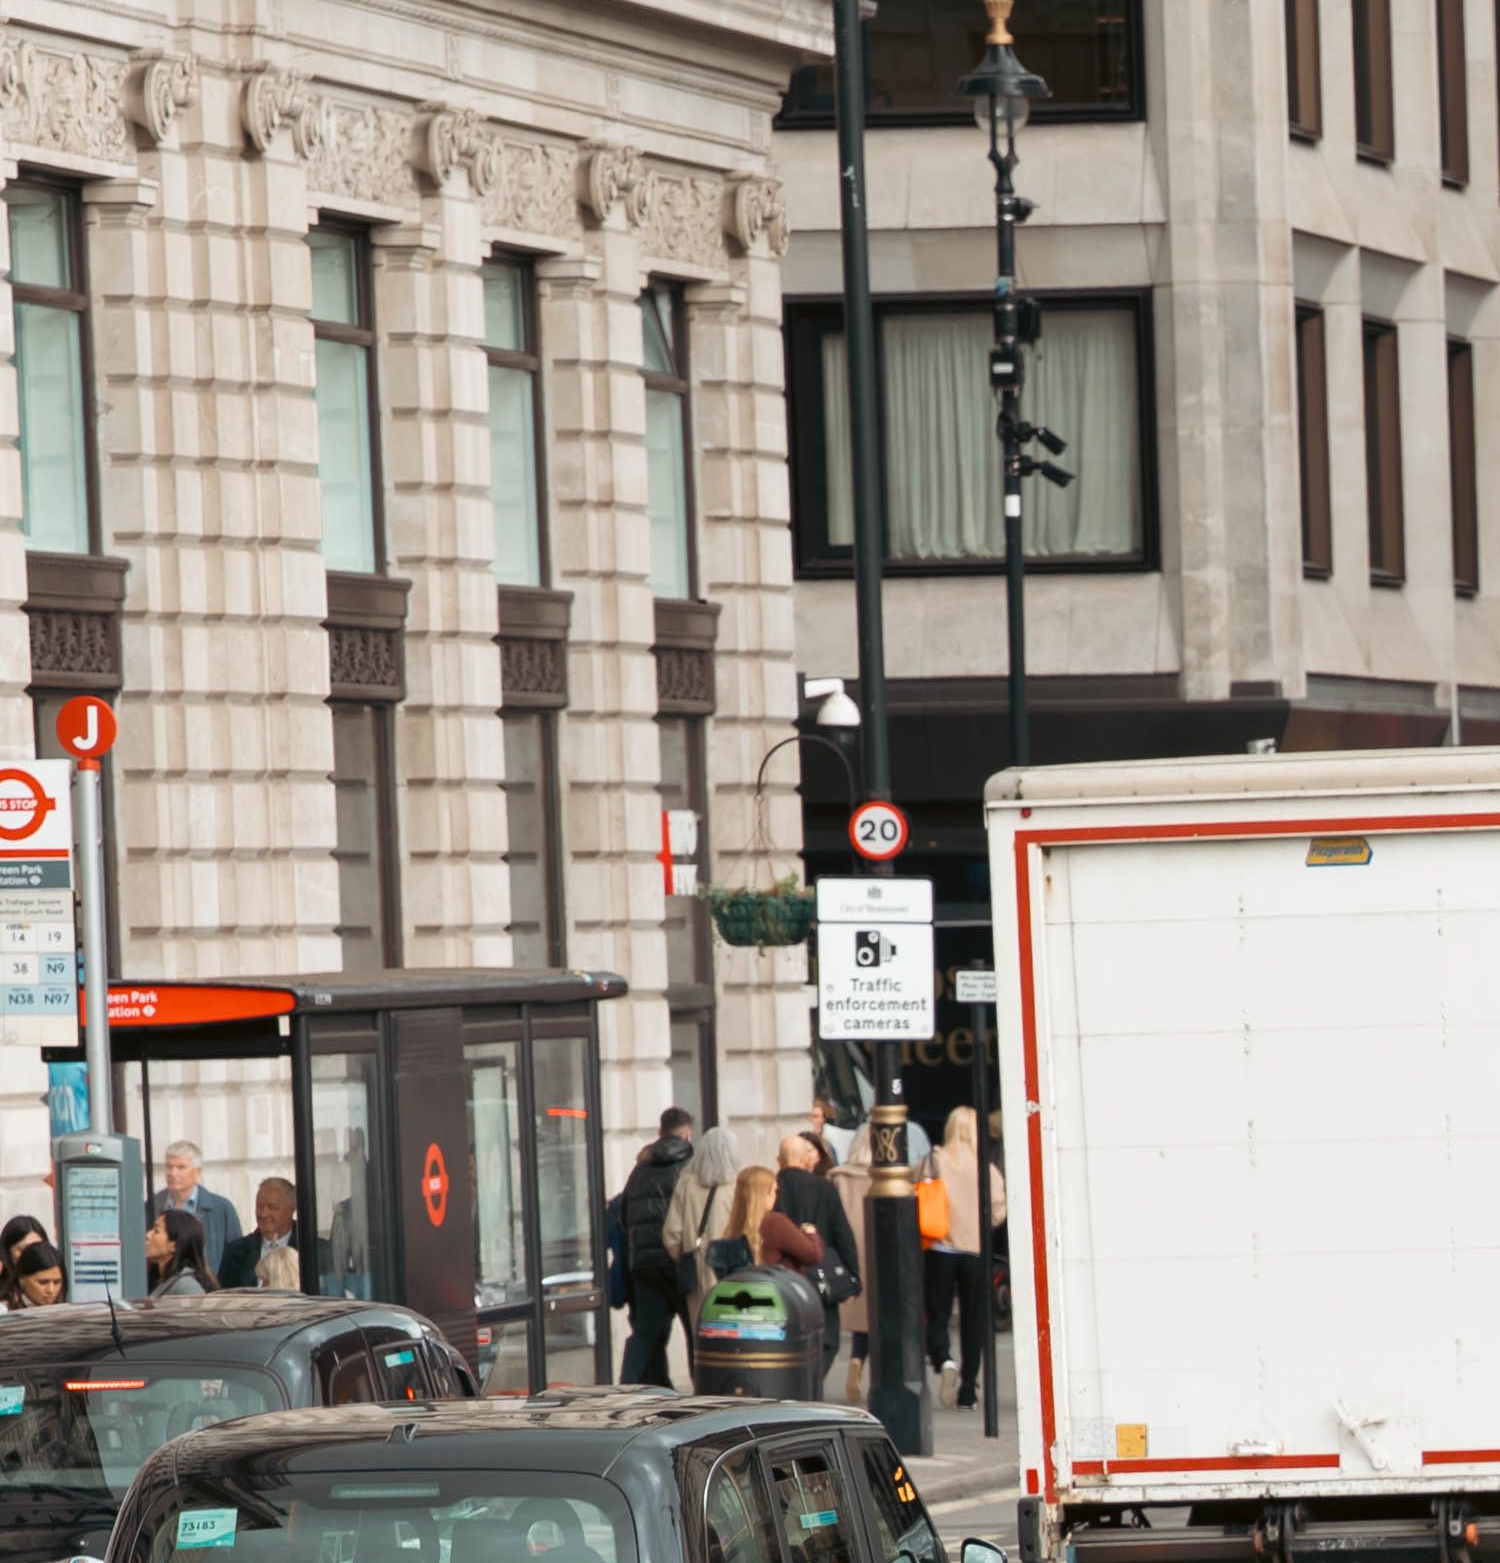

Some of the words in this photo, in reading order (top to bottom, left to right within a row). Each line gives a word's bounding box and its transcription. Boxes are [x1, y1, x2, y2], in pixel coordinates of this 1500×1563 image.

[72, 705, 98, 750] J
[9, 798, 38, 810] STOP
[860, 819, 898, 841] 20
[0, 866, 20, 875] reen
[21, 865, 43, 875] Park
[0, 876, 28, 886] tation
[12, 932, 26, 942] 14
[48, 932, 62, 942] 19
[13, 962, 28, 974] 38
[47, 962, 65, 974] N9
[850, 978, 902, 992] Traffic
[8, 993, 34, 1005] N38
[43, 993, 71, 1005] N97
[108, 993, 129, 1003] een
[131, 991, 158, 1003] Park
[826, 997, 928, 1012] enforcement
[109, 1006, 140, 1017] ation
[843, 1017, 911, 1030] cameras
